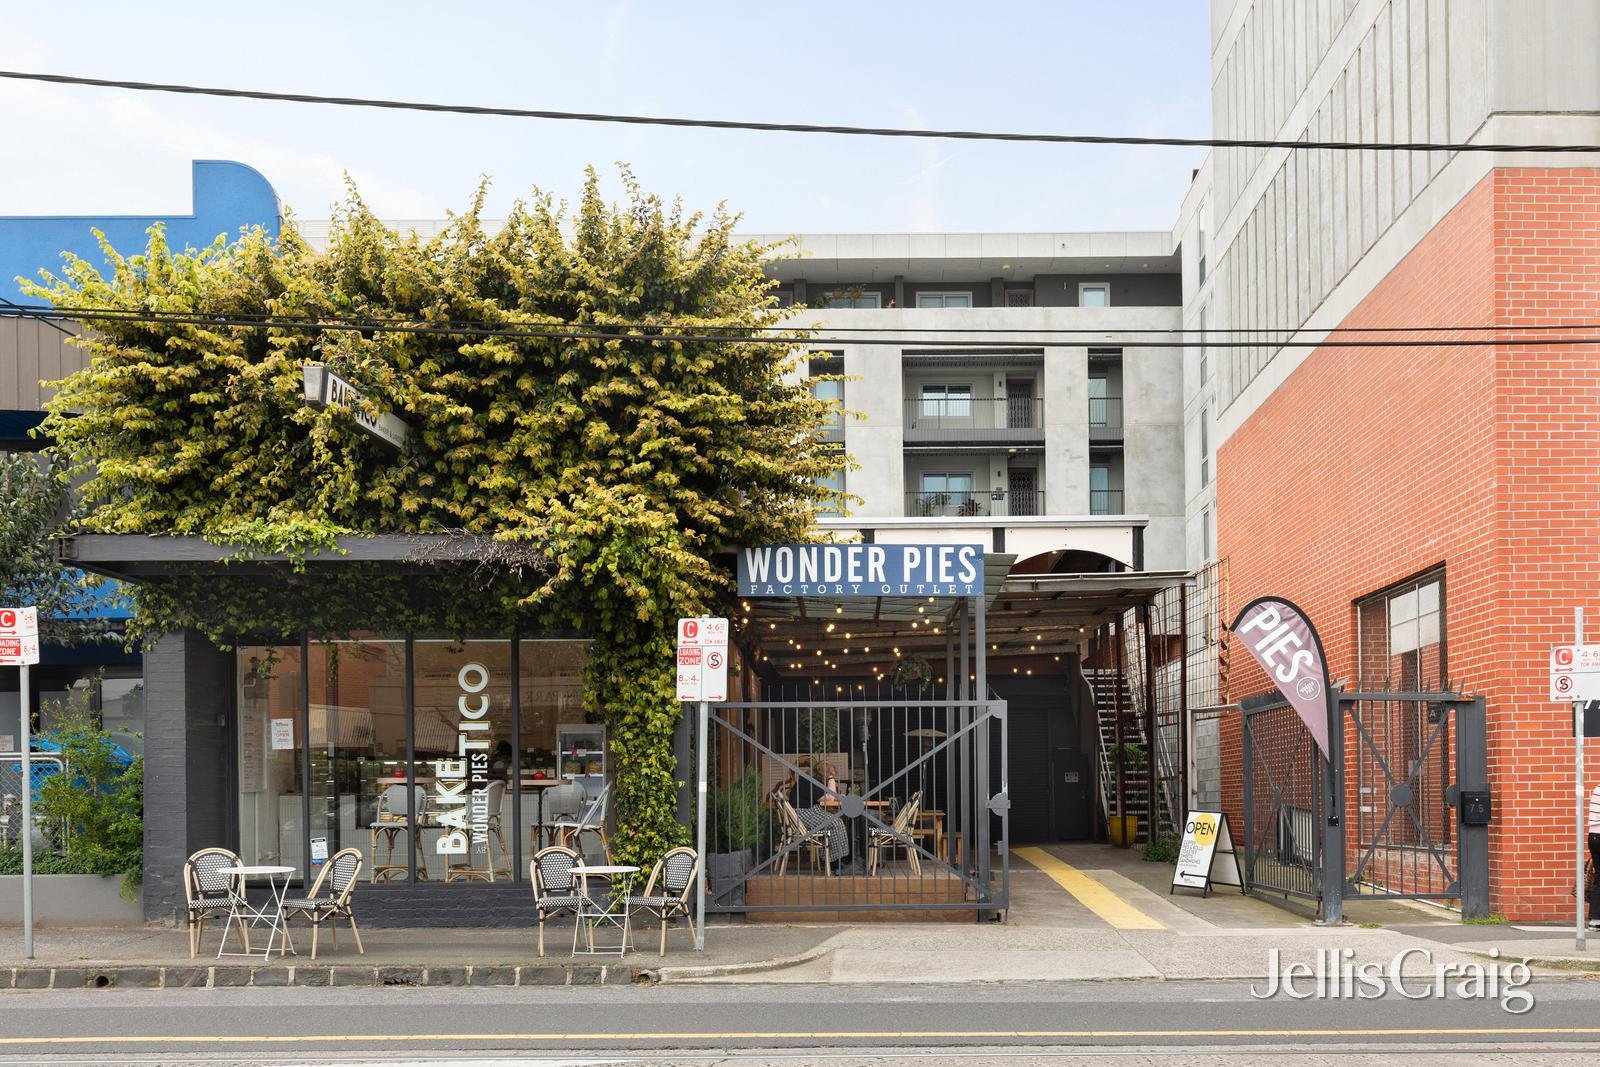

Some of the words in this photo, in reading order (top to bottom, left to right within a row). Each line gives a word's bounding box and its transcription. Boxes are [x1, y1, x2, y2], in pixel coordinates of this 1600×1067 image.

[745, 546, 886, 584] WONDER
[903, 546, 977, 584] PIES
[750, 584, 860, 594] FACTORY
[881, 584, 973, 594] OUTLET
[0, 639, 20, 647] ADING
[1240, 606, 1314, 683] PIES
[680, 657, 701, 665] ZONE
[472, 753, 489, 786] PIES
[472, 788, 489, 844] WONDER
[1186, 821, 1216, 836] OPEN
